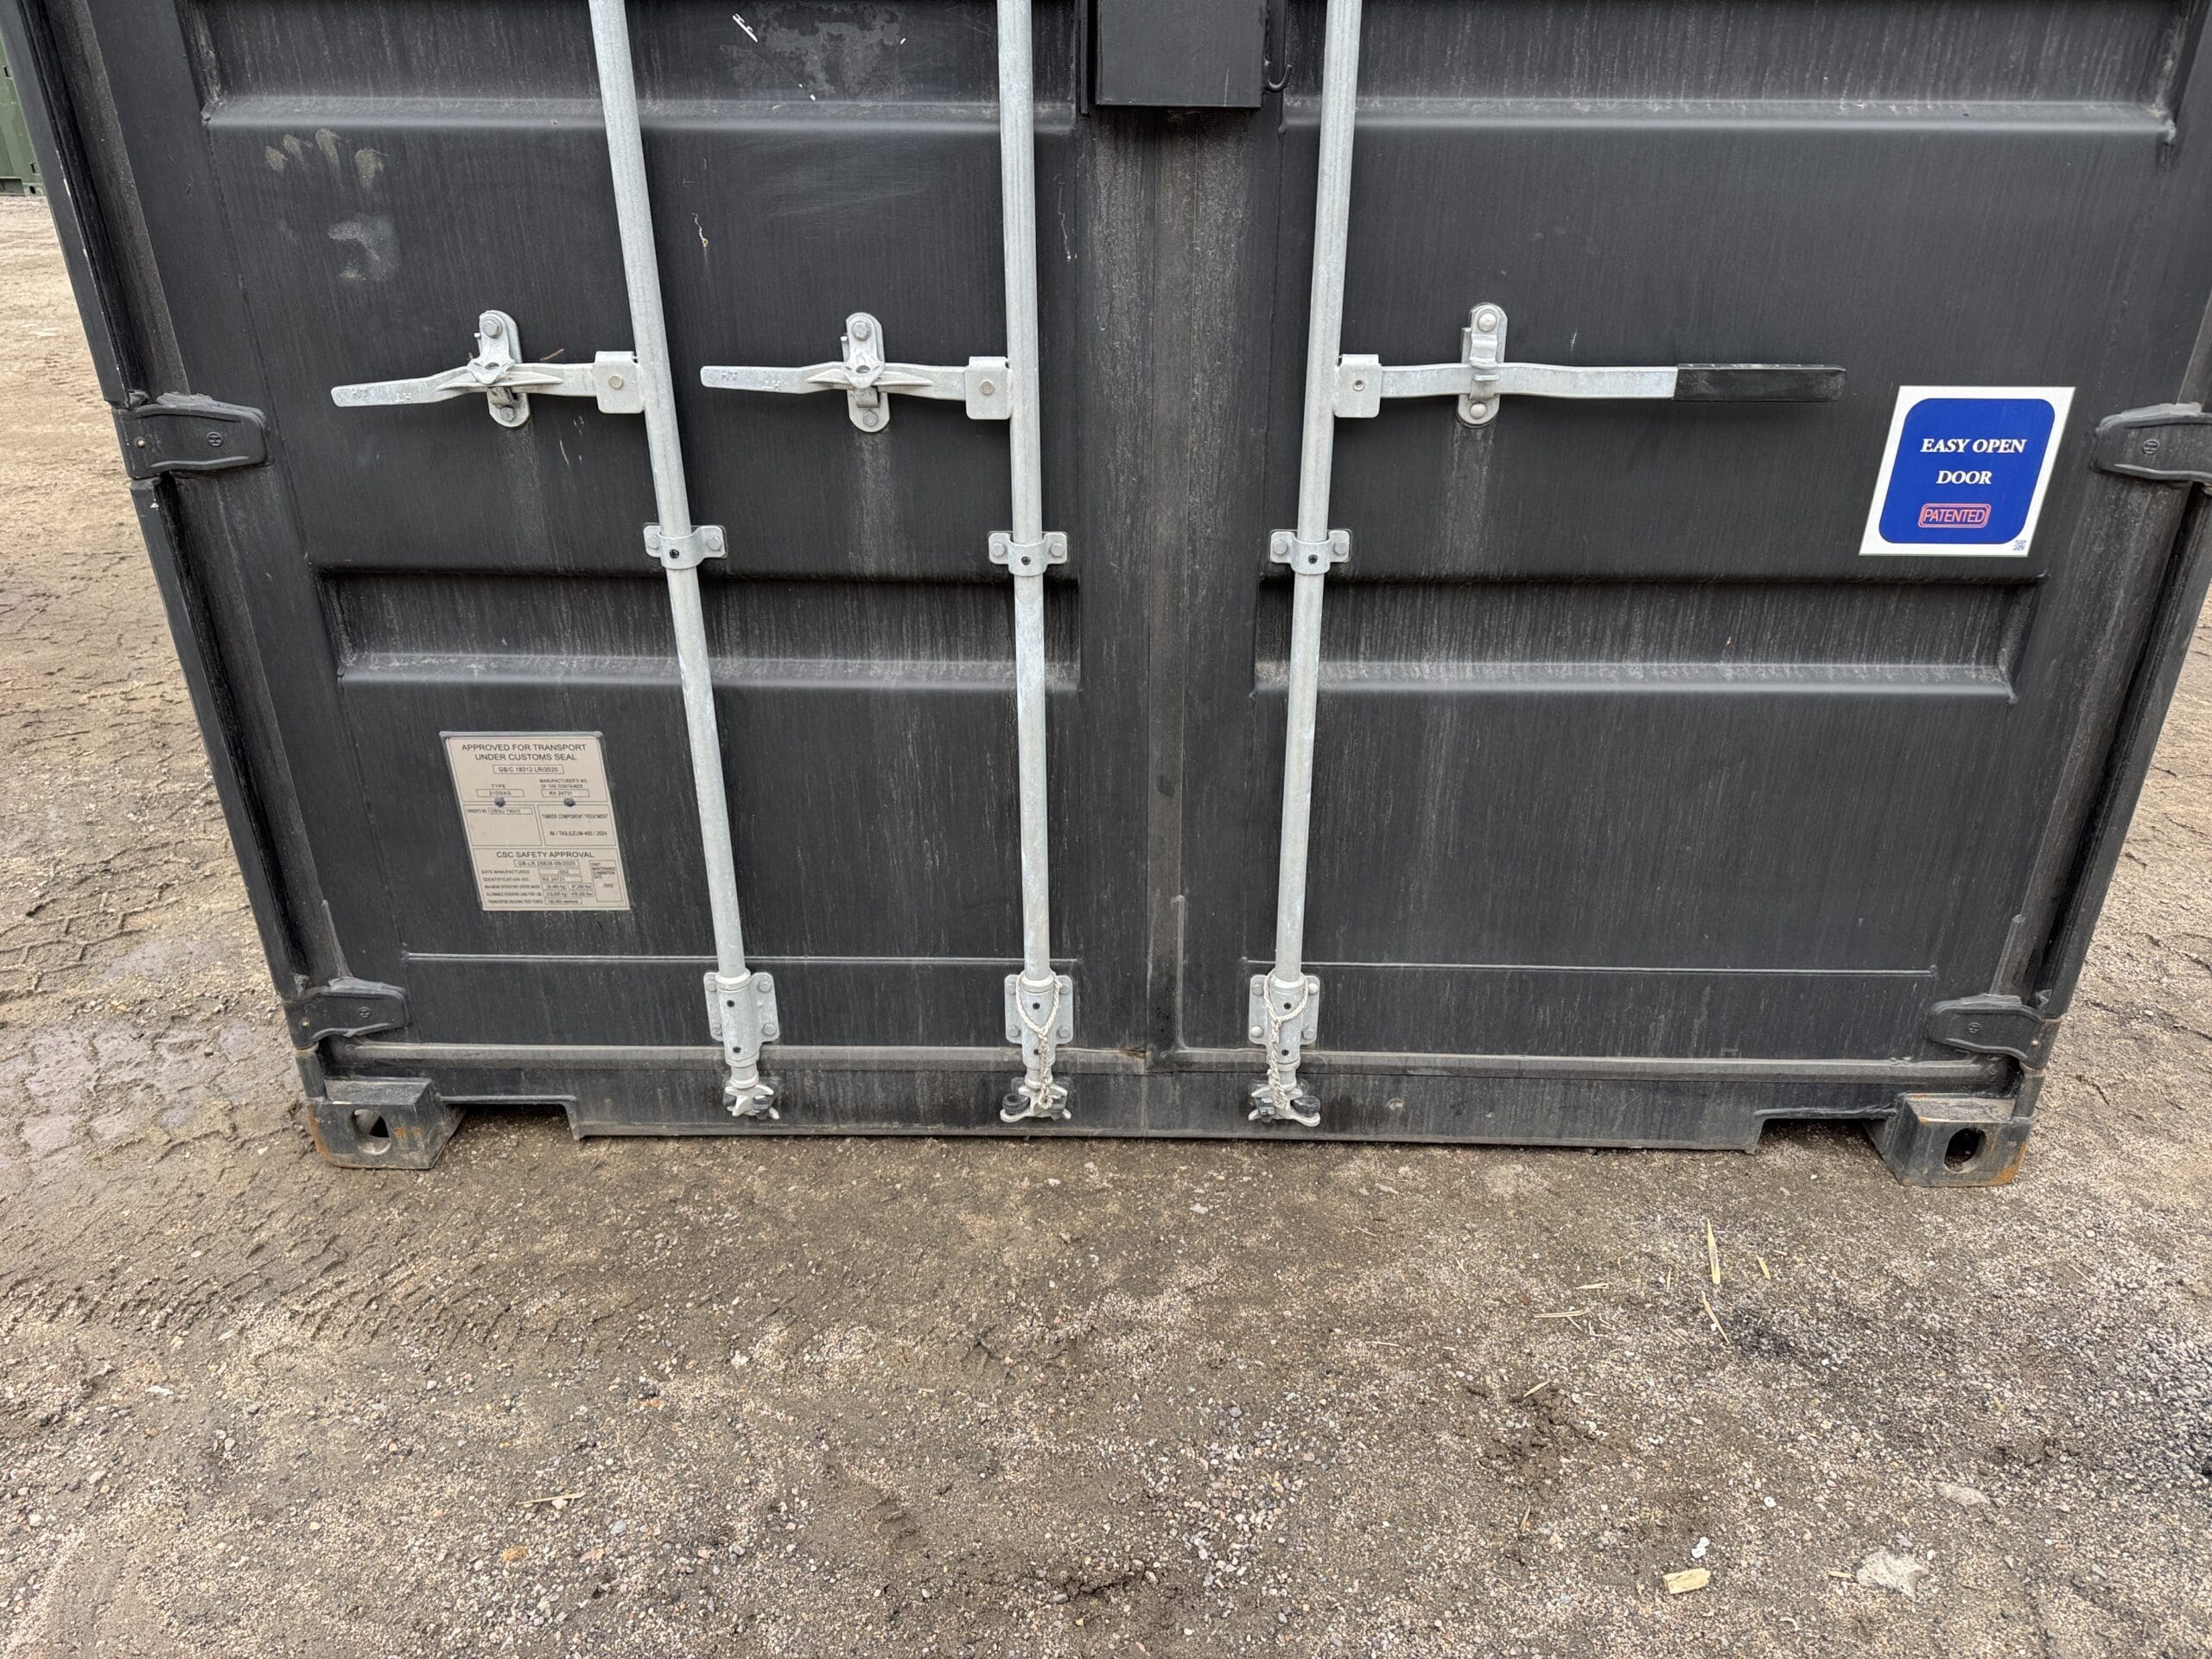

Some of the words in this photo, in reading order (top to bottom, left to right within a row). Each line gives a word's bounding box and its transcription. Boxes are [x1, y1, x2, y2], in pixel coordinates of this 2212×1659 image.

[1920, 438, 1970, 453] EASY
[1972, 438, 2027, 454] OPEN
[1936, 470, 1993, 485] DOOR
[1923, 508, 1986, 523] PATENTED
[532, 743, 586, 752] TRANSPORT
